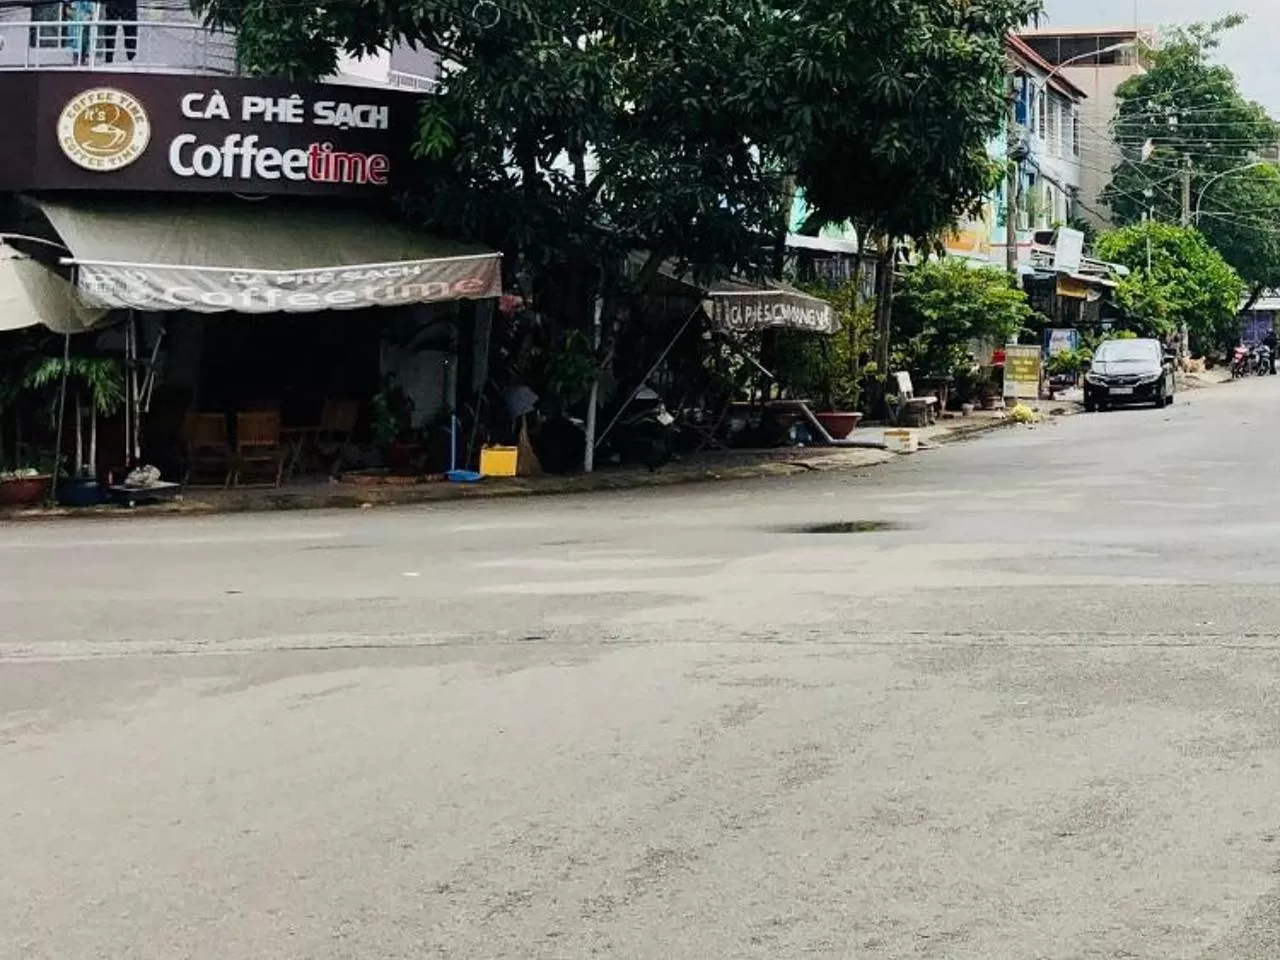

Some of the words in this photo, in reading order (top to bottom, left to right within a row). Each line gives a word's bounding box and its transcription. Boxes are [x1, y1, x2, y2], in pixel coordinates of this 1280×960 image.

[181, 89, 231, 120] CÀ
[241, 94, 305, 124] PHÊ
[313, 100, 389, 131] SẠCH
[169, 133, 390, 185] Coffeetime
